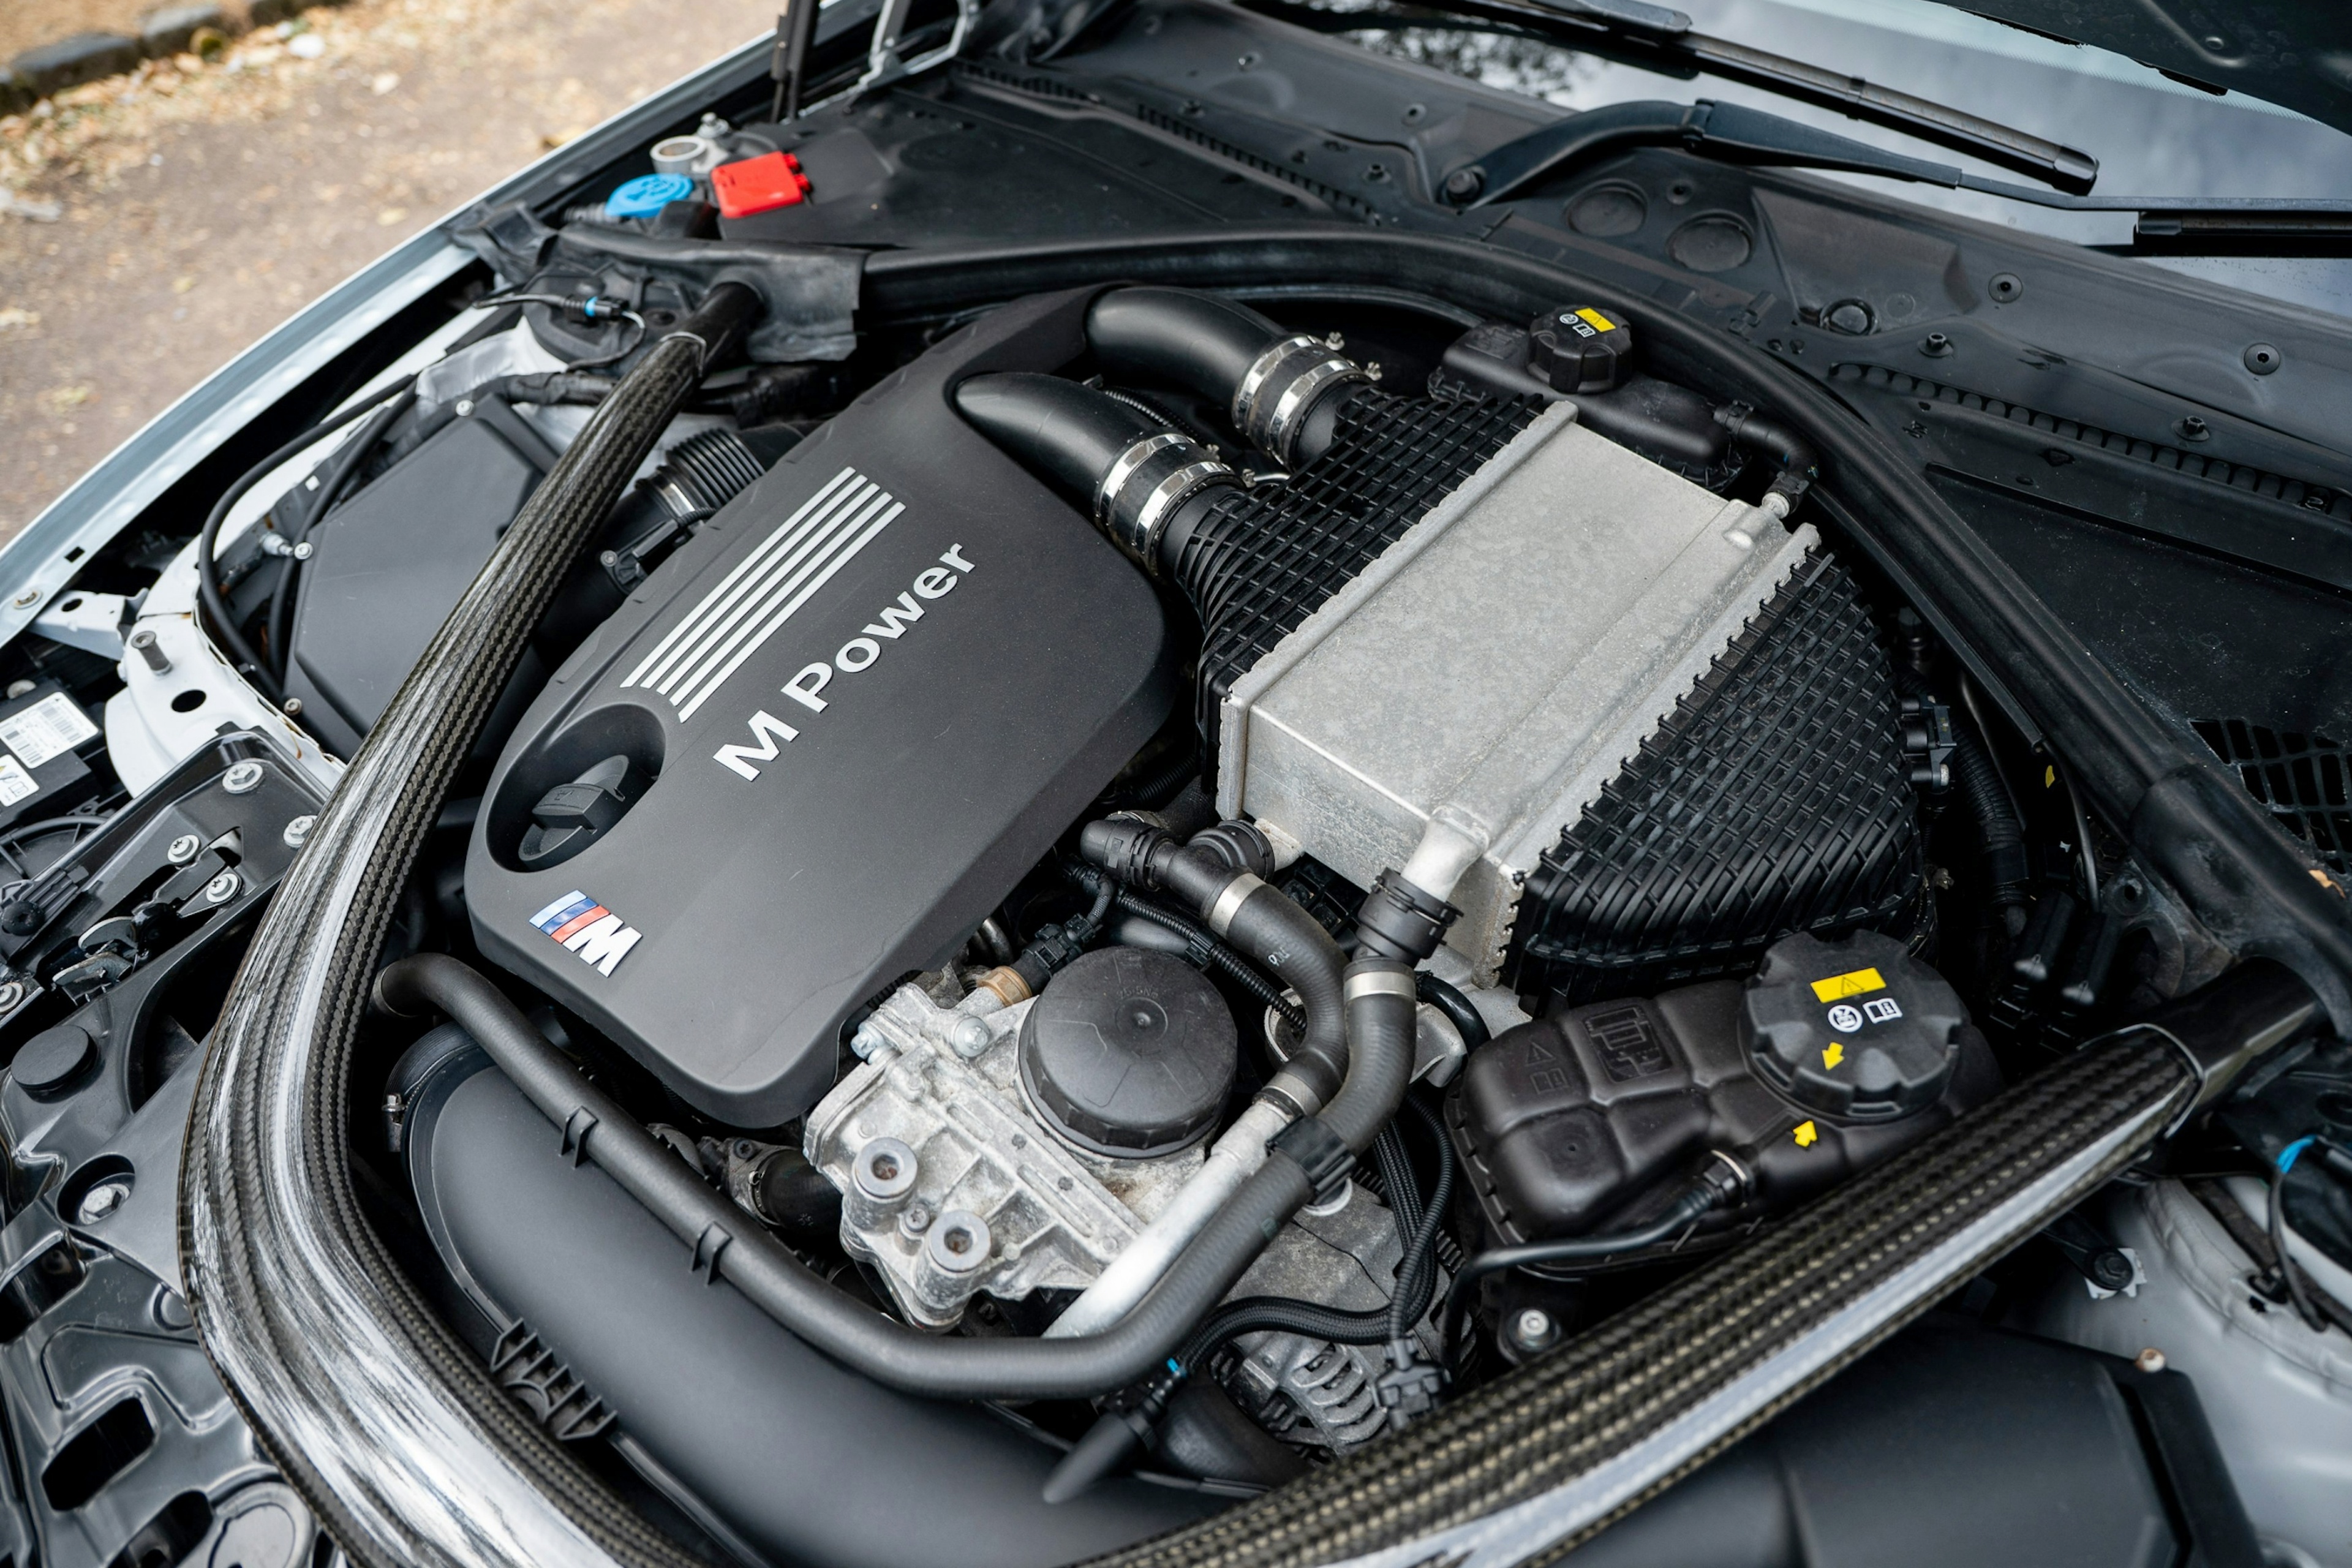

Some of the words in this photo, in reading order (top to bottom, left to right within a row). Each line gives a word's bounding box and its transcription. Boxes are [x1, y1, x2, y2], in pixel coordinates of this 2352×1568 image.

[712, 709, 800, 782] M
[780, 543, 976, 714] Power
[560, 913, 644, 979] M
